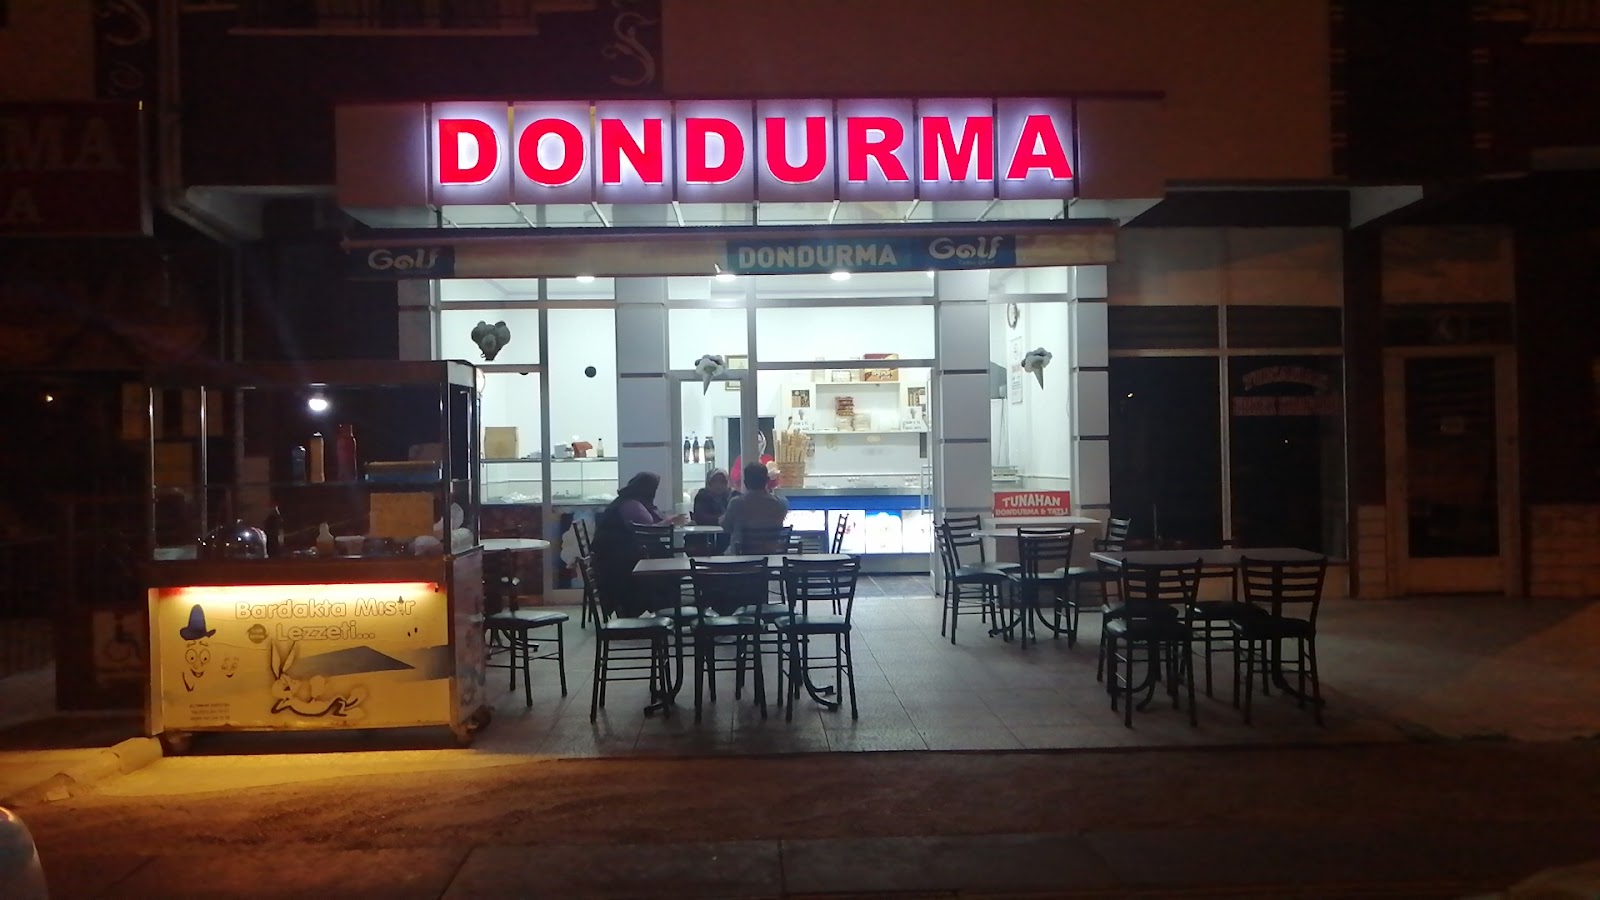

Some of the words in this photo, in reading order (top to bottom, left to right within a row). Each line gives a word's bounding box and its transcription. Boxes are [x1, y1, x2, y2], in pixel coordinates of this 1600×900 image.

[438, 115, 1074, 187] DONDURMA
[367, 248, 440, 270] Golf
[738, 243, 897, 269] DONDURMA
[928, 236, 1004, 260] Golf
[1002, 493, 1061, 508] TUNAHAN
[995, 507, 1040, 517] DONDURMA
[234, 598, 347, 620] Bardakta
[275, 620, 376, 642] Lezzeti...
